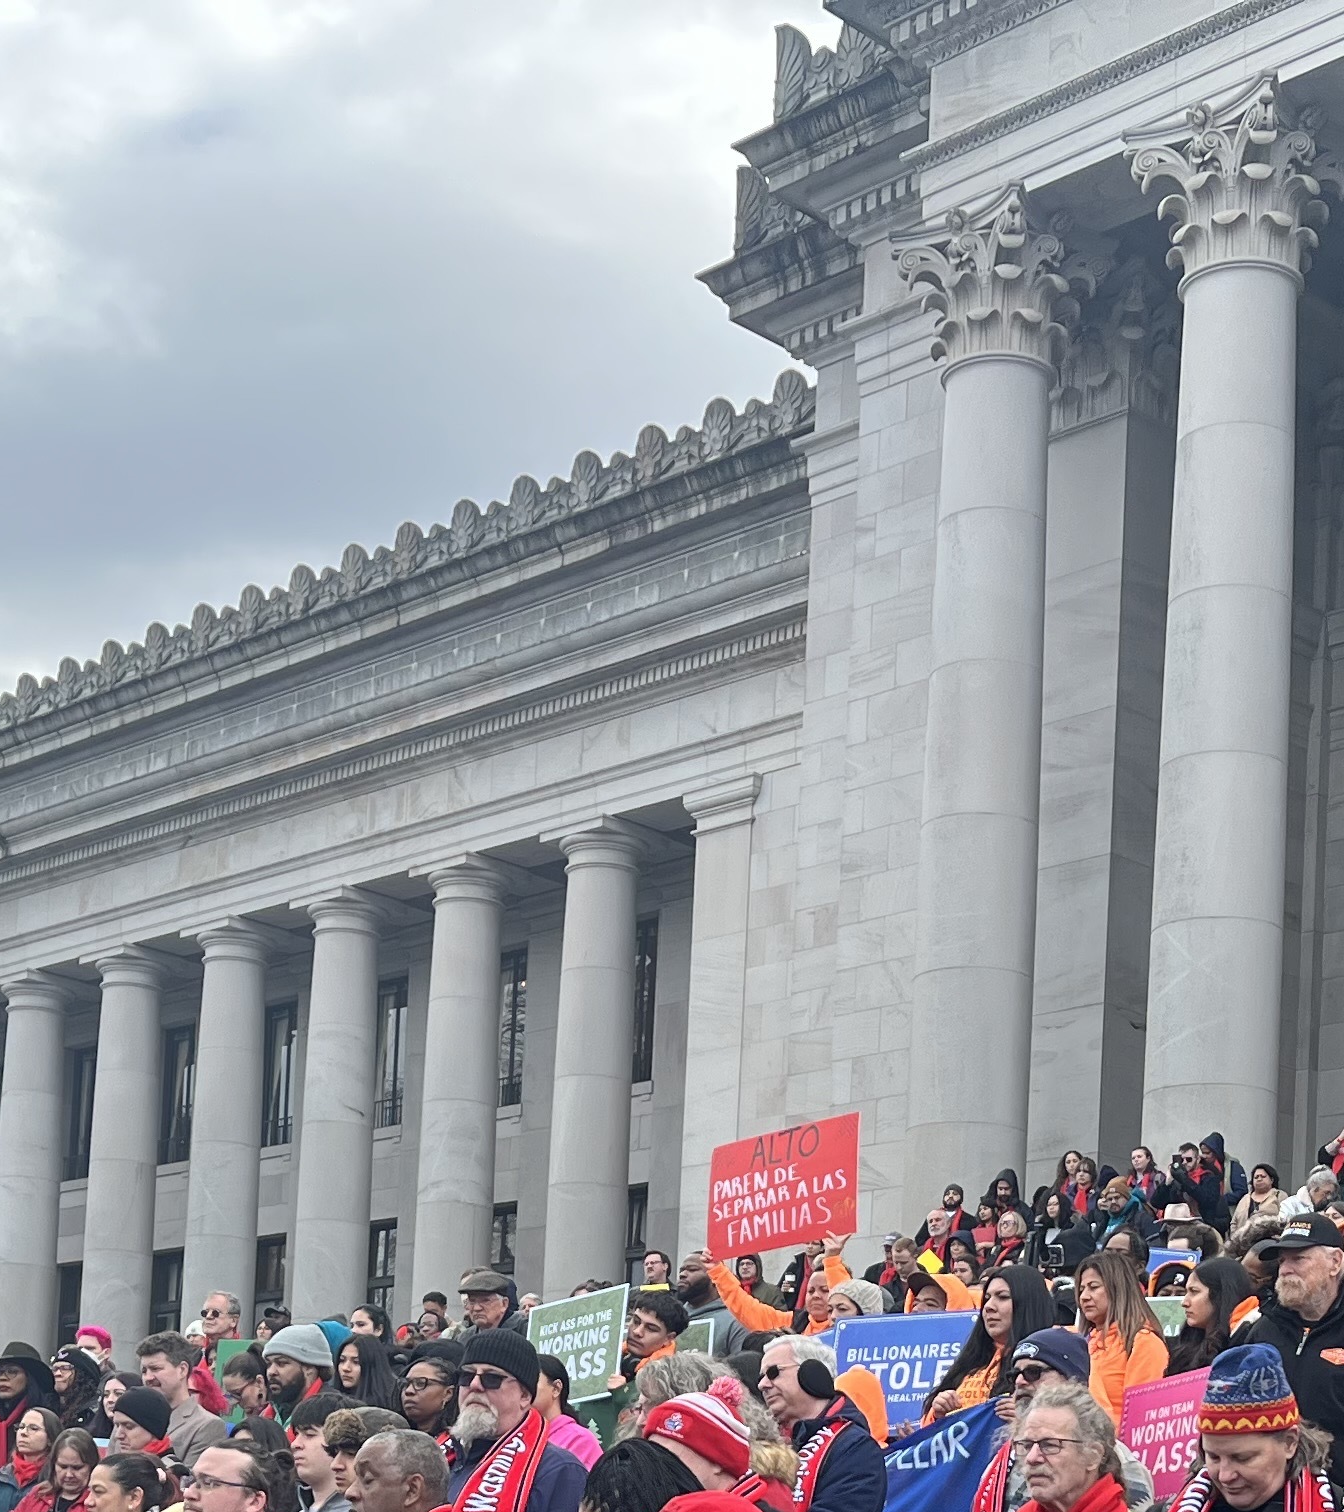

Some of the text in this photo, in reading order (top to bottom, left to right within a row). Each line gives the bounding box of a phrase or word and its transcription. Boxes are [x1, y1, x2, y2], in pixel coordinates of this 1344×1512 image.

[750, 1124, 820, 1169] ALTO
[712, 1168, 847, 1223] SEPARAR A LAS
[713, 1162, 801, 1203] PAREN DE
[727, 1196, 832, 1248] FAMILIAS
[538, 1324, 611, 1355] WORKING
[539, 1308, 612, 1337] KICK ASS FOR THE
[846, 1342, 961, 1363] BILLIONAIRES
[1158, 1406, 1170, 1419] ON
[1171, 1400, 1195, 1416] TEAM
